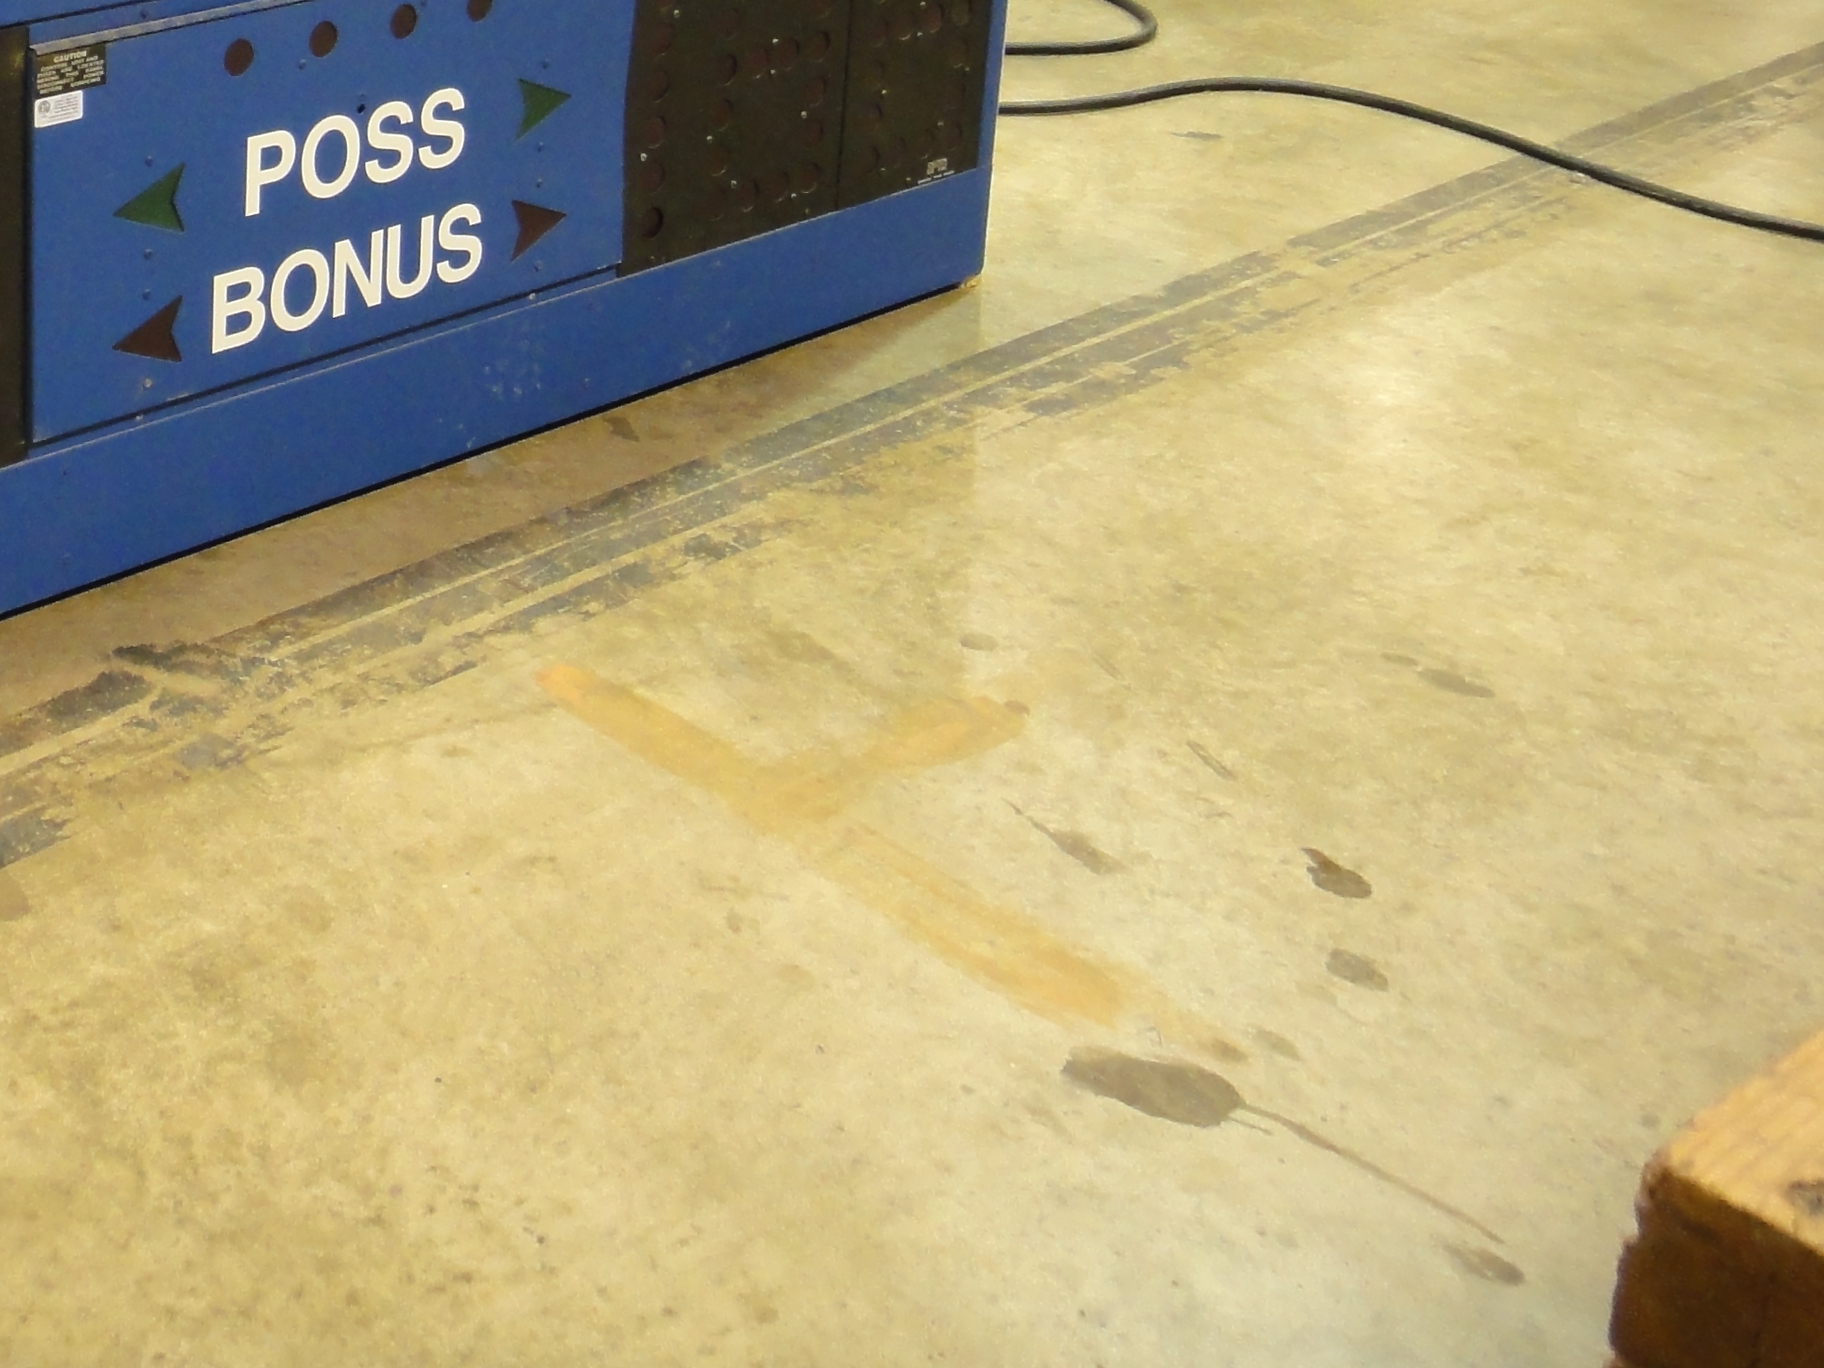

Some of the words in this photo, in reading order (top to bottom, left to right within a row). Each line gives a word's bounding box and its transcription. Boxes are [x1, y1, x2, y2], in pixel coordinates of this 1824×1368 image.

[53, 50, 87, 63] CAUTION
[244, 87, 465, 217] POSS
[211, 202, 483, 355] BONUS
